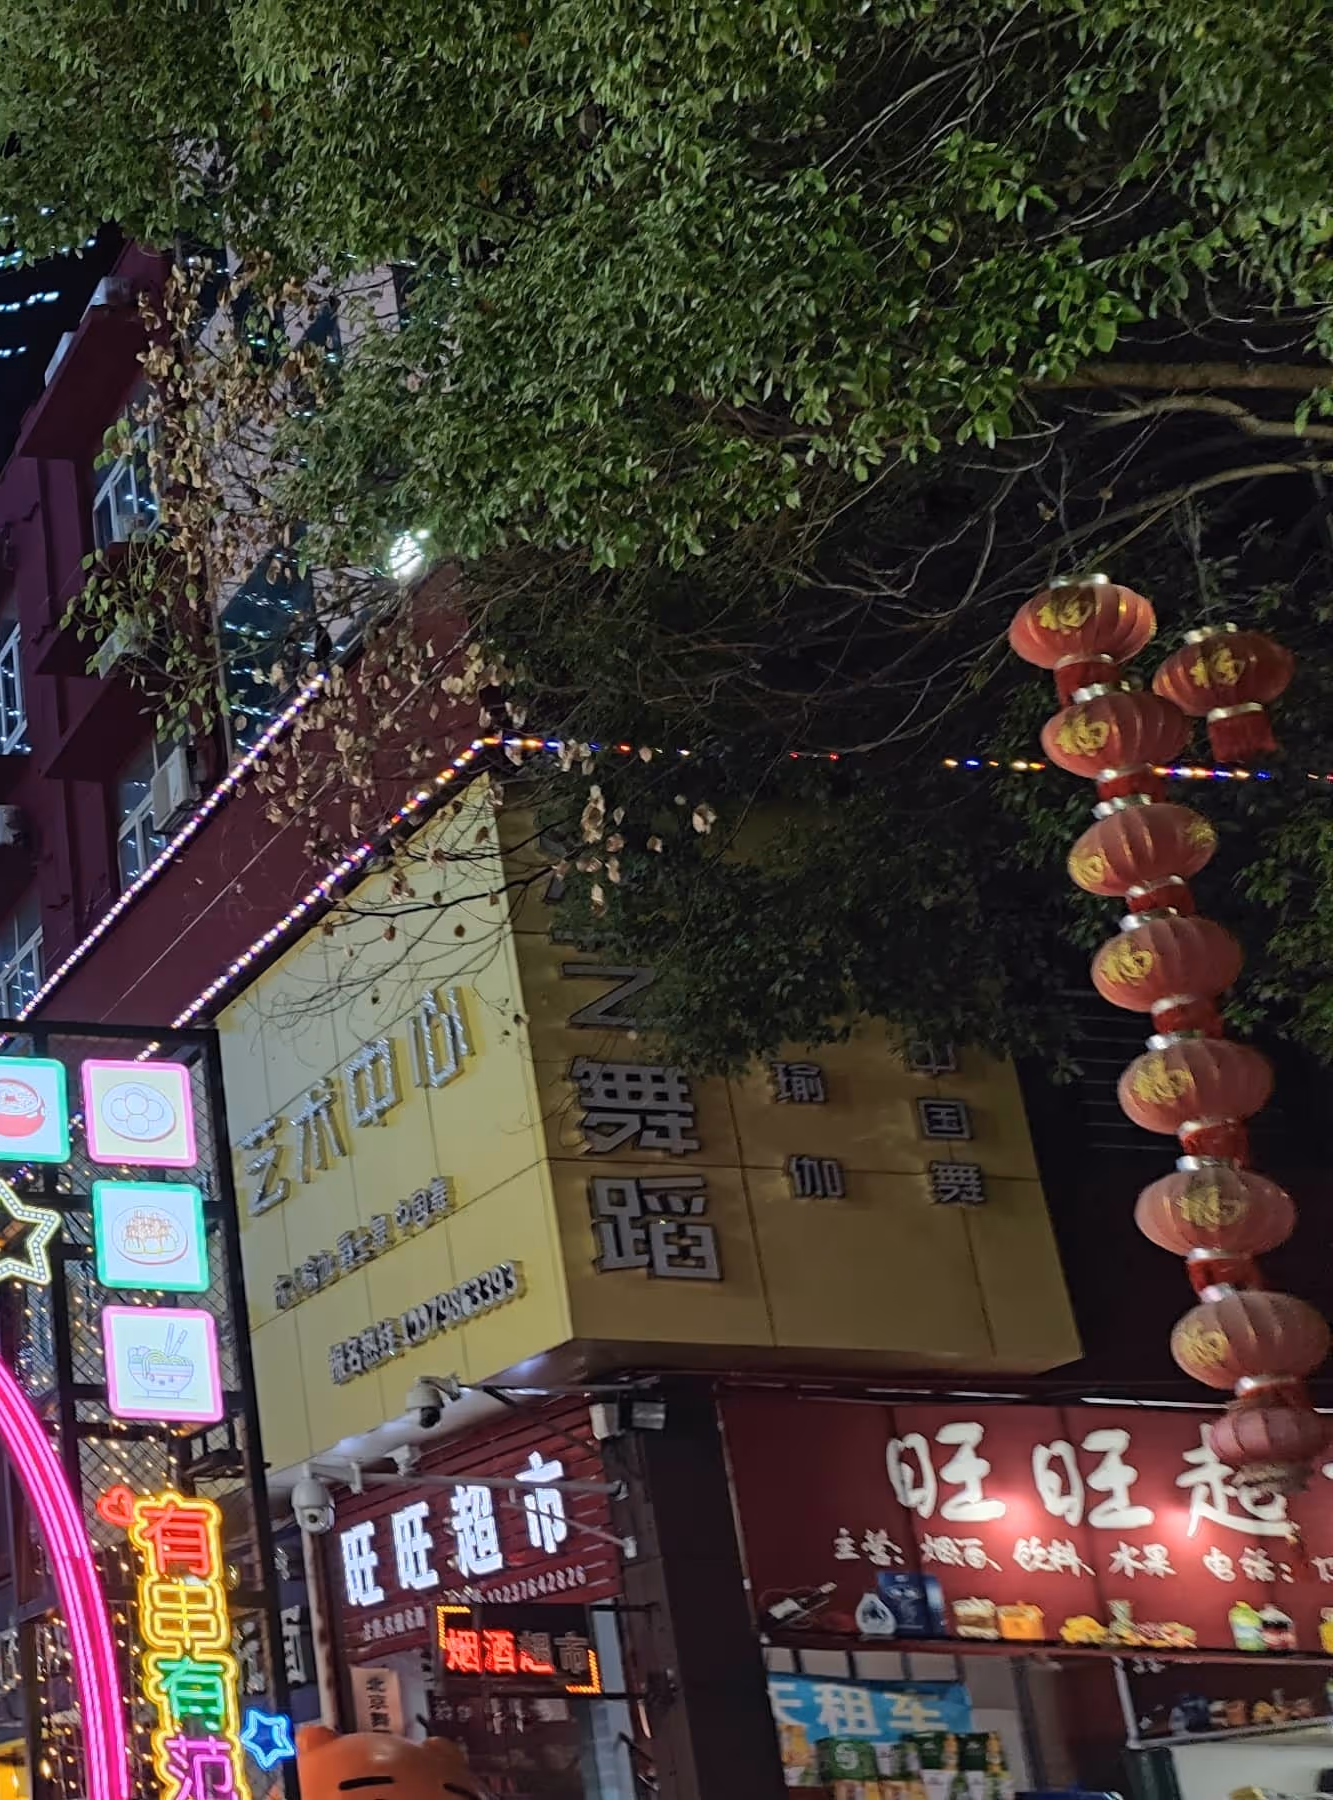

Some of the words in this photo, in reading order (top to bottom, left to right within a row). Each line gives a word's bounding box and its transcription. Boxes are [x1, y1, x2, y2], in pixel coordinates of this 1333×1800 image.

[233, 986, 475, 1217] 艺术中心
[771, 1061, 845, 1199] 瑜伽
[341, 1451, 567, 1608] 旺旺超市
[1109, 1541, 1177, 1579] 水果
[445, 1628, 590, 1675] 烟酒超市
